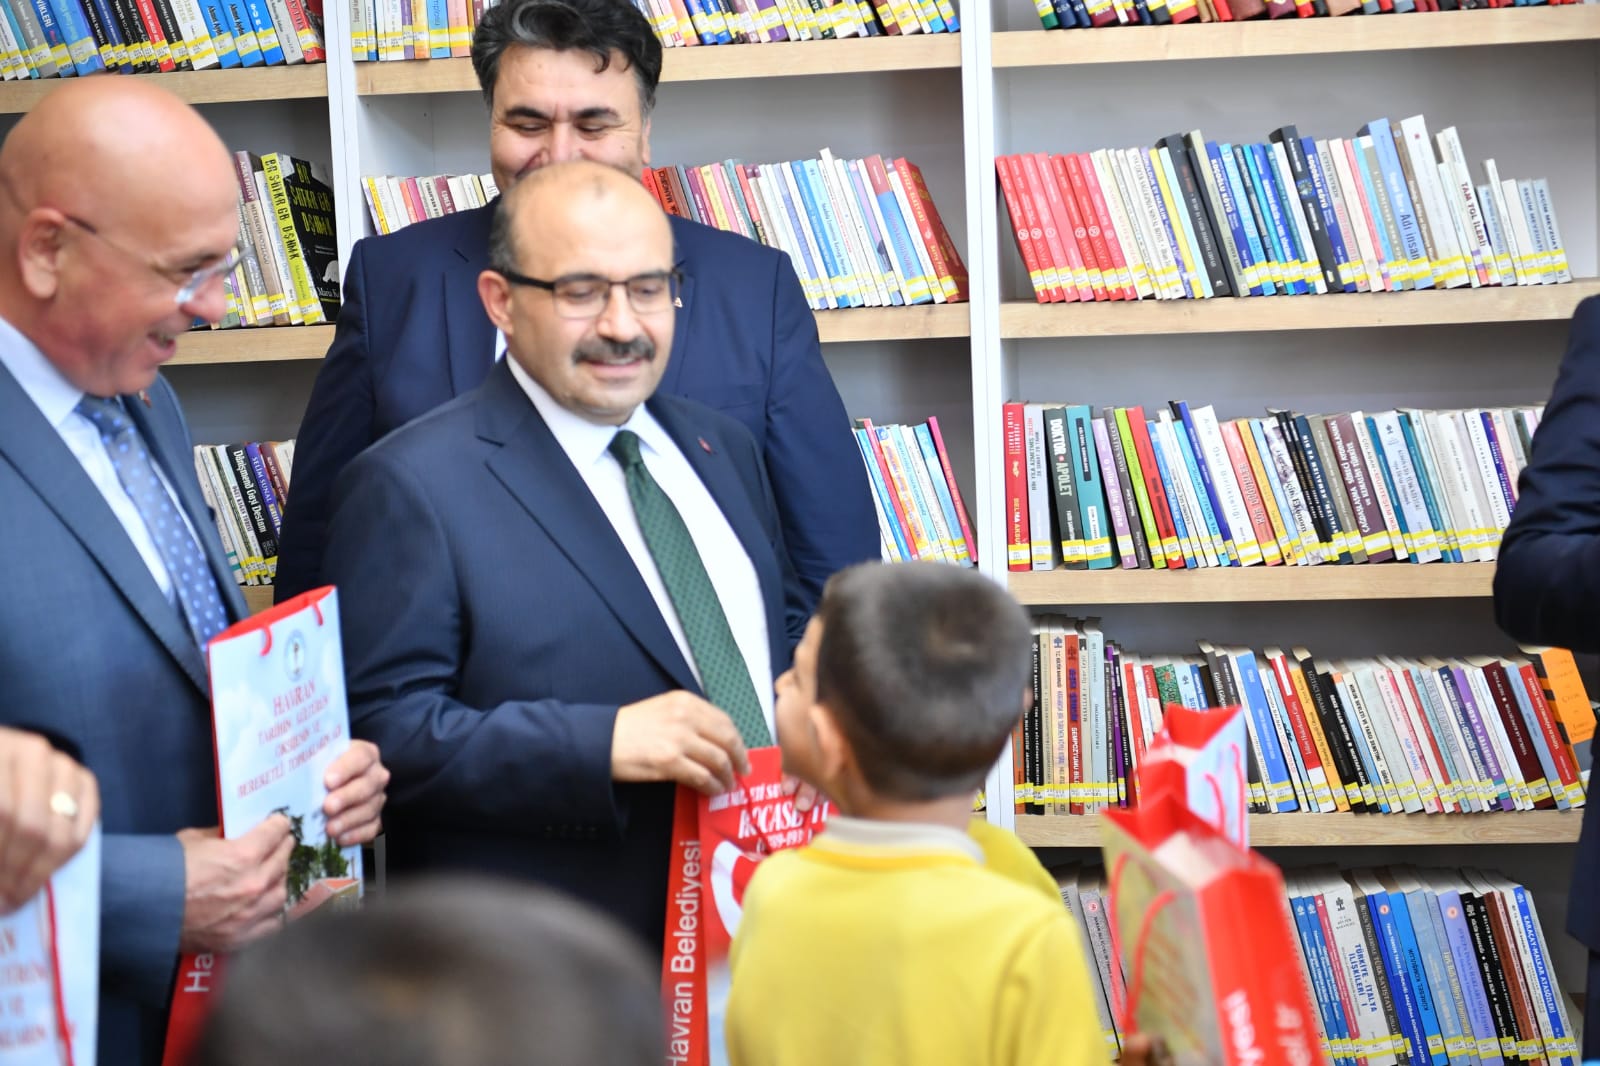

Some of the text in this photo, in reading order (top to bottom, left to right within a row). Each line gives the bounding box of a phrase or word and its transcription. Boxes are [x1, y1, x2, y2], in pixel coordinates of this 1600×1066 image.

[1399, 212, 1414, 230] Adı
[1460, 181, 1472, 201] TAM
[1467, 203, 1478, 220] YOL
[1405, 231, 1423, 259] insan
[1047, 418, 1074, 497] DOKTOR APOLET
[1464, 700, 1478, 724] KADIN
[1070, 727, 1080, 770] SEMPOZYUMU
[670, 839, 704, 973] Belediyesi
[1347, 952, 1366, 996] İLİŞKİLERİ
[1354, 943, 1378, 1013] TÜRKİYE İTALYA
[1372, 956, 1383, 975] TÜRK
